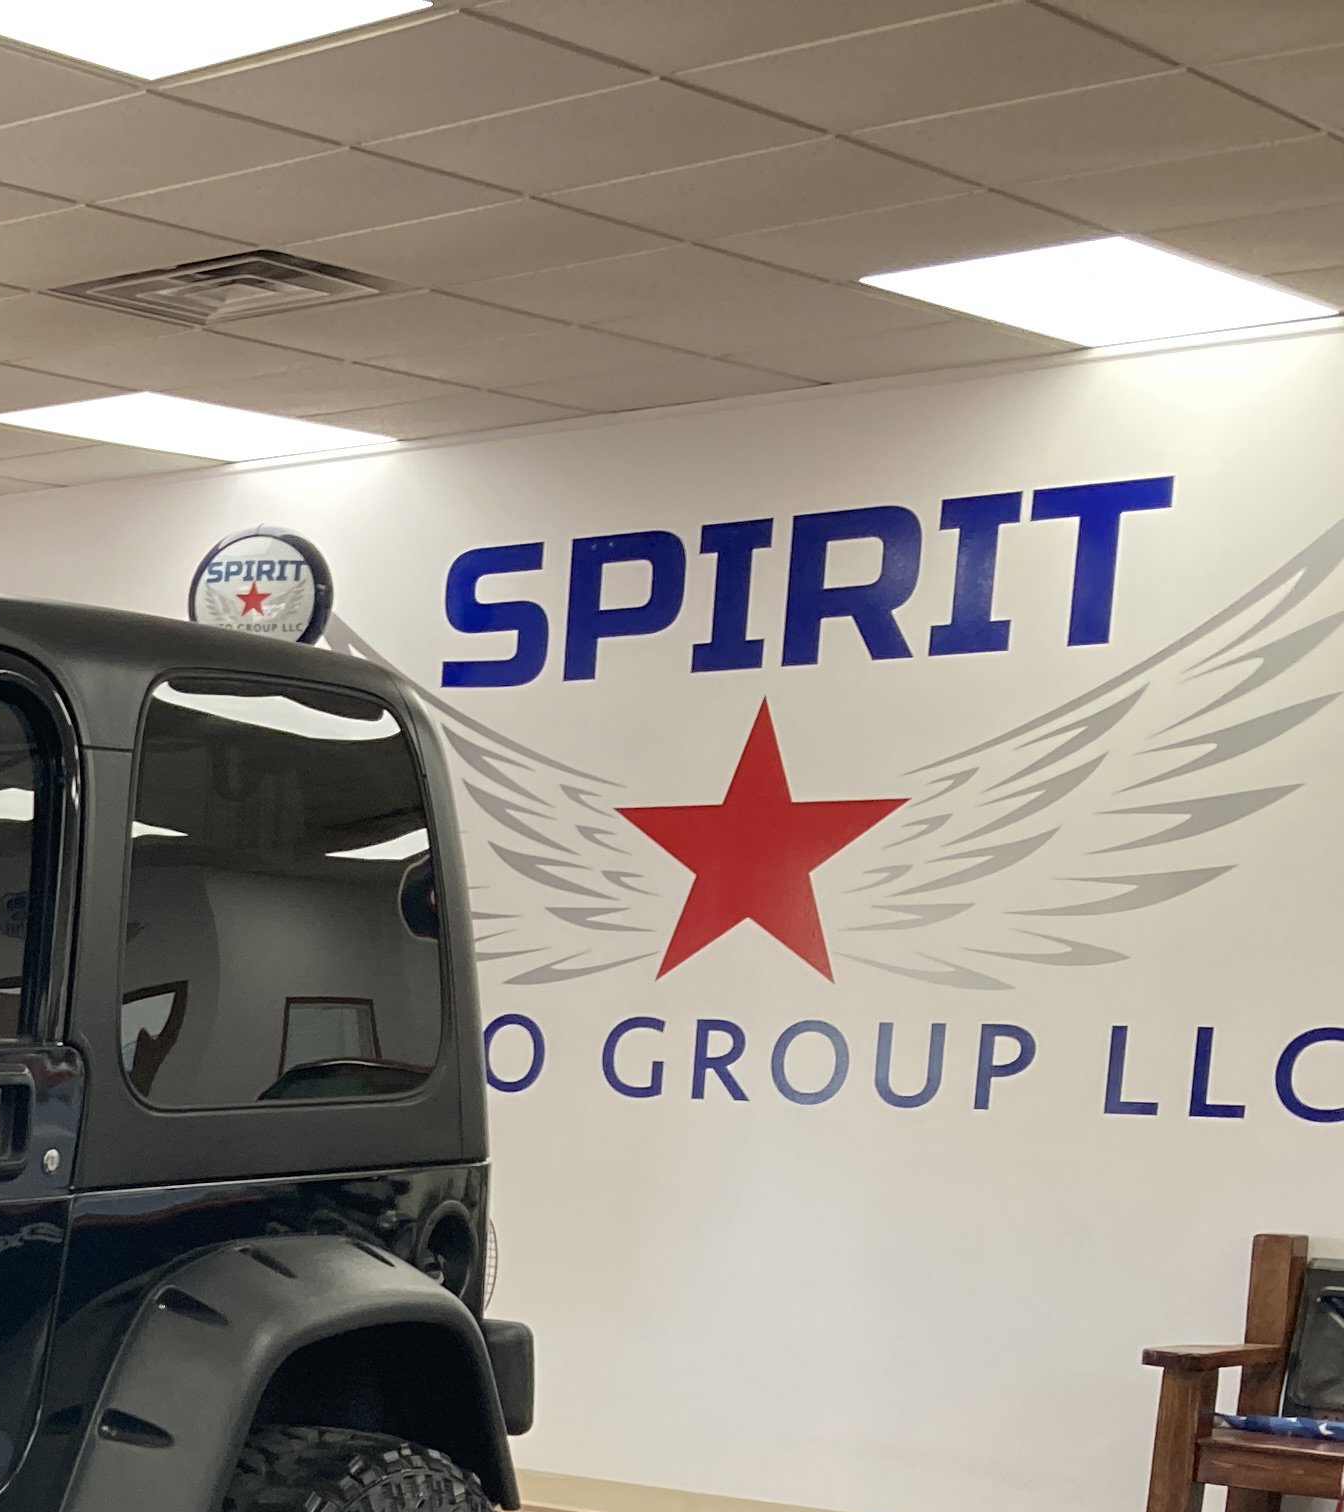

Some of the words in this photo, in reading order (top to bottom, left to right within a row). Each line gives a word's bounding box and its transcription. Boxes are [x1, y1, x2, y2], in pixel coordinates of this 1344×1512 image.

[206, 559, 306, 583] SPIRIT
[440, 475, 1175, 689] SPIRIT
[282, 622, 303, 633] LLC
[602, 1016, 1036, 1110] GROUP
[1103, 1024, 1344, 1123] LLC
